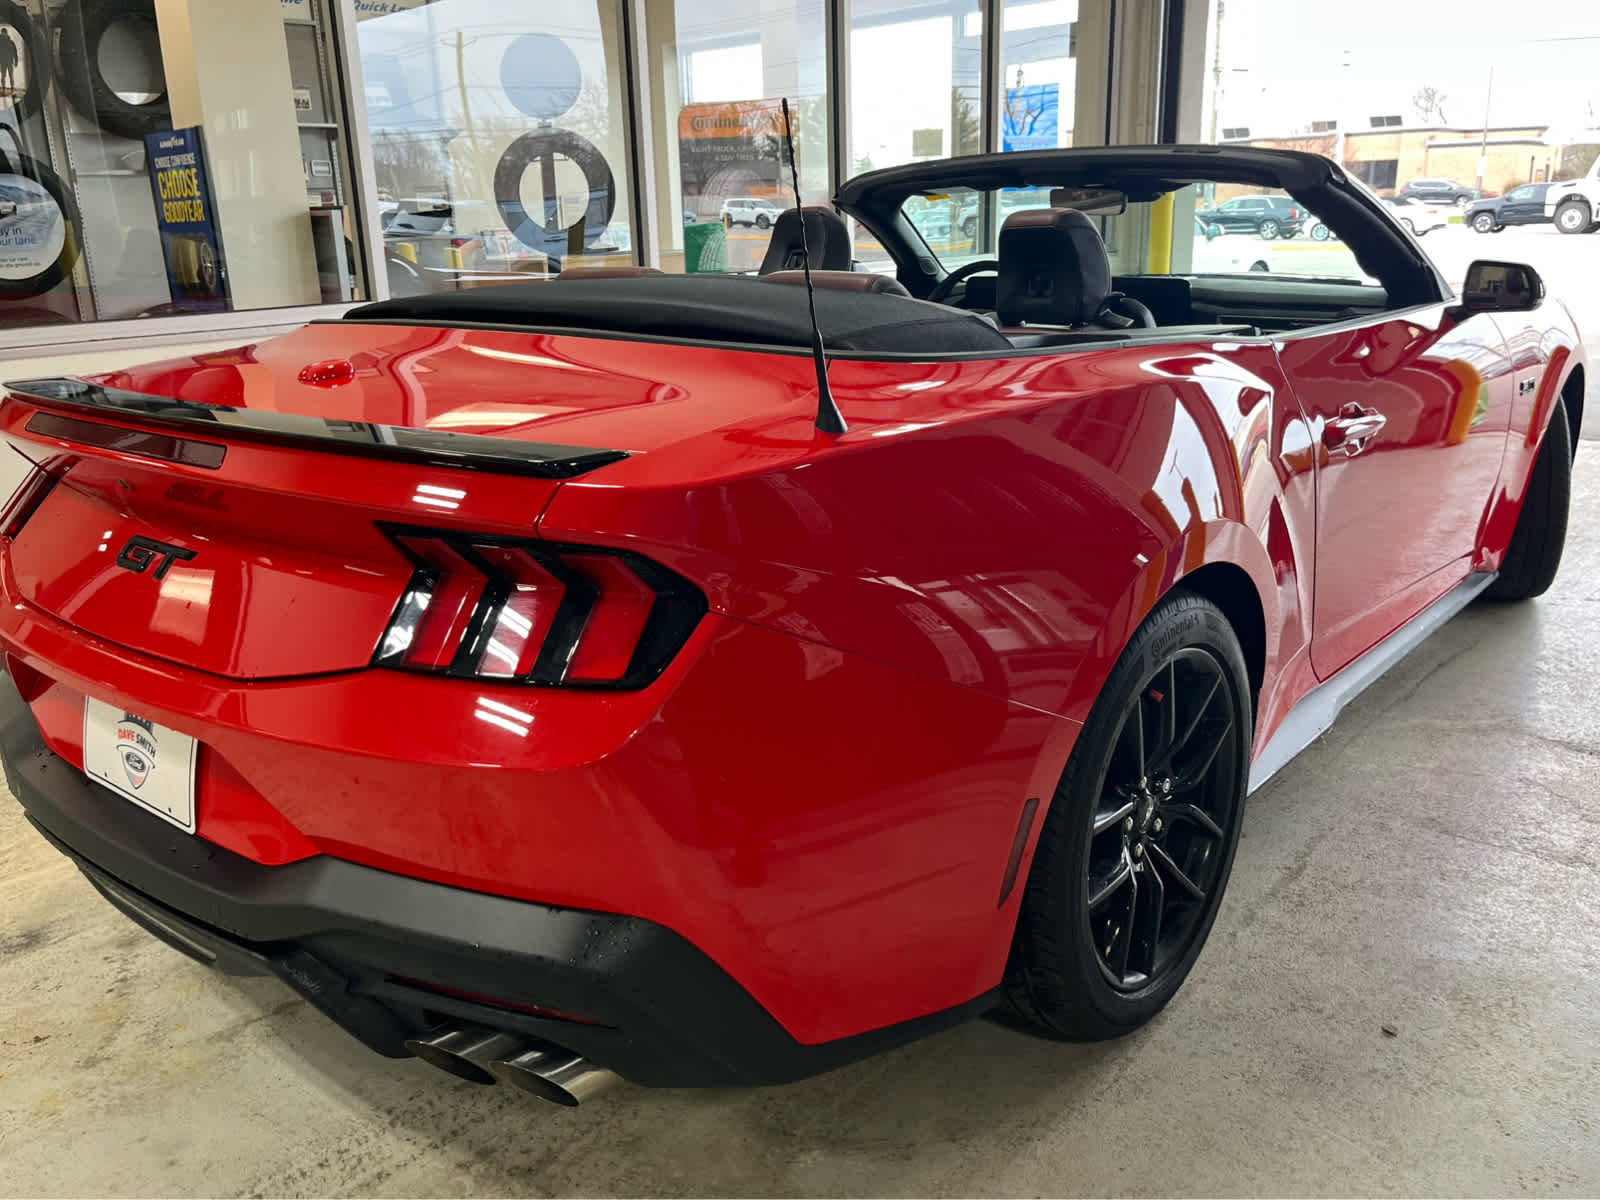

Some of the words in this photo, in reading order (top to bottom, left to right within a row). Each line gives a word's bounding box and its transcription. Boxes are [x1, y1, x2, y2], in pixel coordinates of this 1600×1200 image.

[157, 168, 202, 199] CHOOSE
[163, 200, 206, 224] GOODYEAR
[116, 534, 199, 580] GT
[117, 727, 136, 742] DAVE
[136, 733, 156, 758] SMITH
